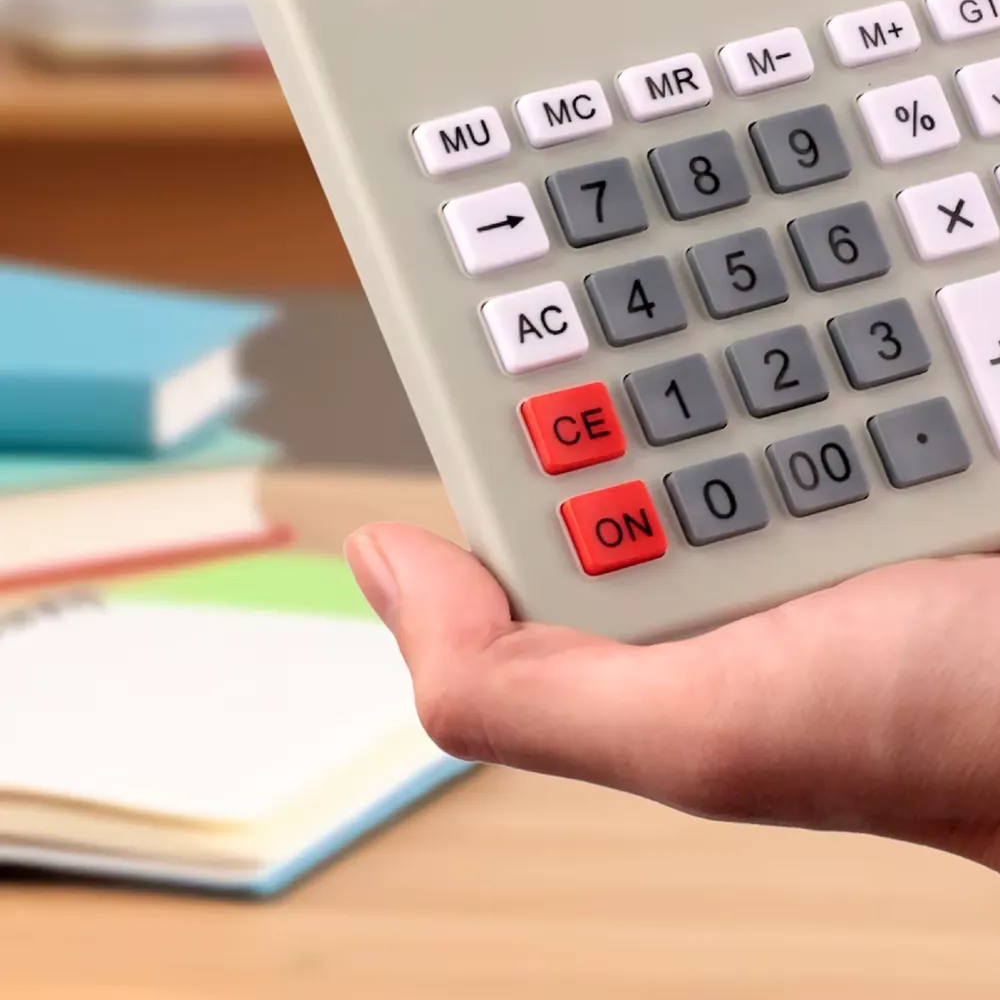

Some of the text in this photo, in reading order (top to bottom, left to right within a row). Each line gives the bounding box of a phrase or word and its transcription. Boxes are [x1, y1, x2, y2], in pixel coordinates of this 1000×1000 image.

[439, 119, 491, 155] MU
[543, 94, 597, 128] MC
[645, 67, 700, 101] MR
[746, 48, 793, 78] M-
[858, 20, 905, 51] M+
[579, 180, 608, 223] 7
[689, 155, 721, 197] 8
[790, 129, 820, 169] 9
[895, 100, 936, 138] %
[517, 305, 570, 345] AC
[626, 278, 656, 320] 4
[725, 250, 757, 293] 5
[828, 225, 860, 265] 6
[552, 407, 611, 447] CE
[663, 378, 691, 420] 1
[763, 348, 800, 391] 2
[870, 321, 903, 361] 3
[595, 508, 655, 549] ON
[703, 478, 738, 521] 0
[788, 442, 853, 490] 00
